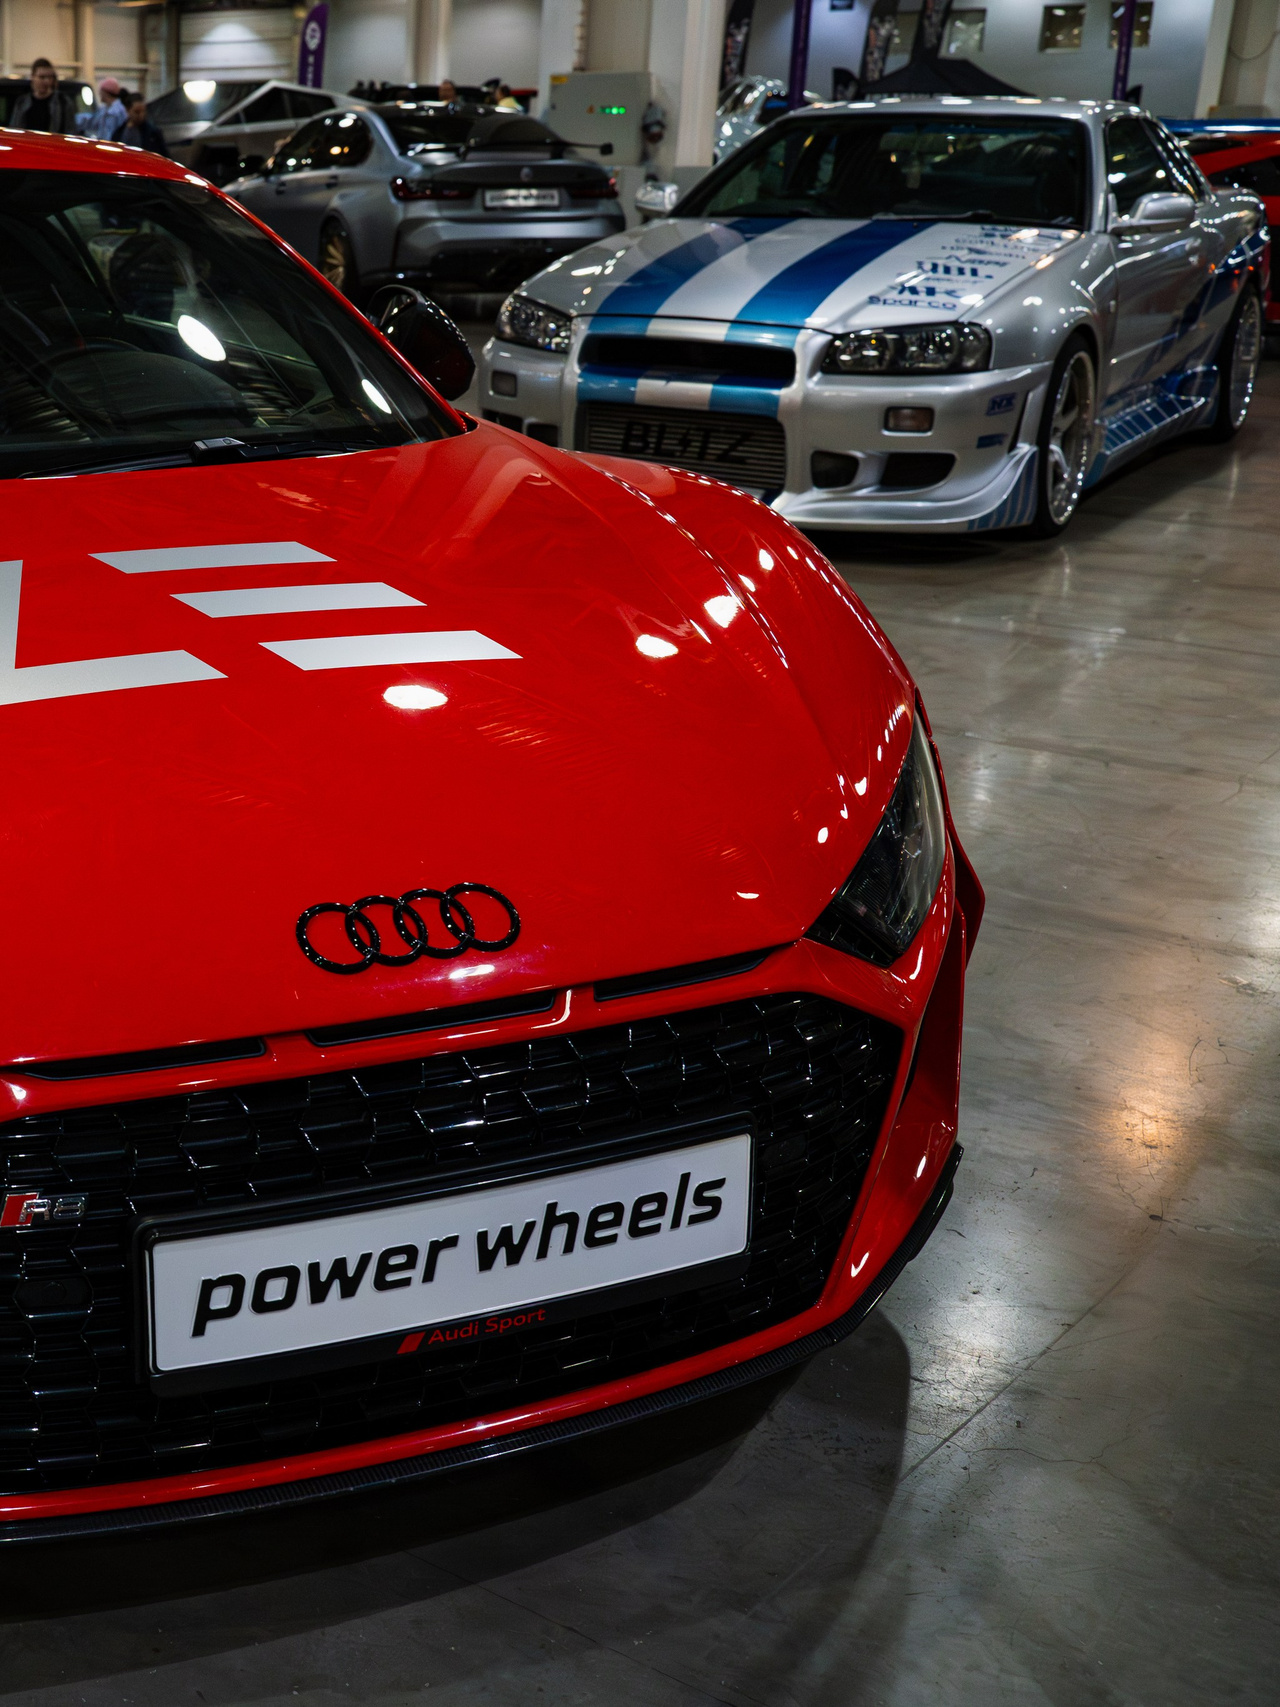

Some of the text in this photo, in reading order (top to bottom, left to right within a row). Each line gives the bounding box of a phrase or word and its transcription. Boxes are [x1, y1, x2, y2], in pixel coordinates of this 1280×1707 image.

[19, 1197, 85, 1222] R8
[189, 1171, 727, 1339] power wheels
[428, 1308, 546, 1345] Audi Sport
